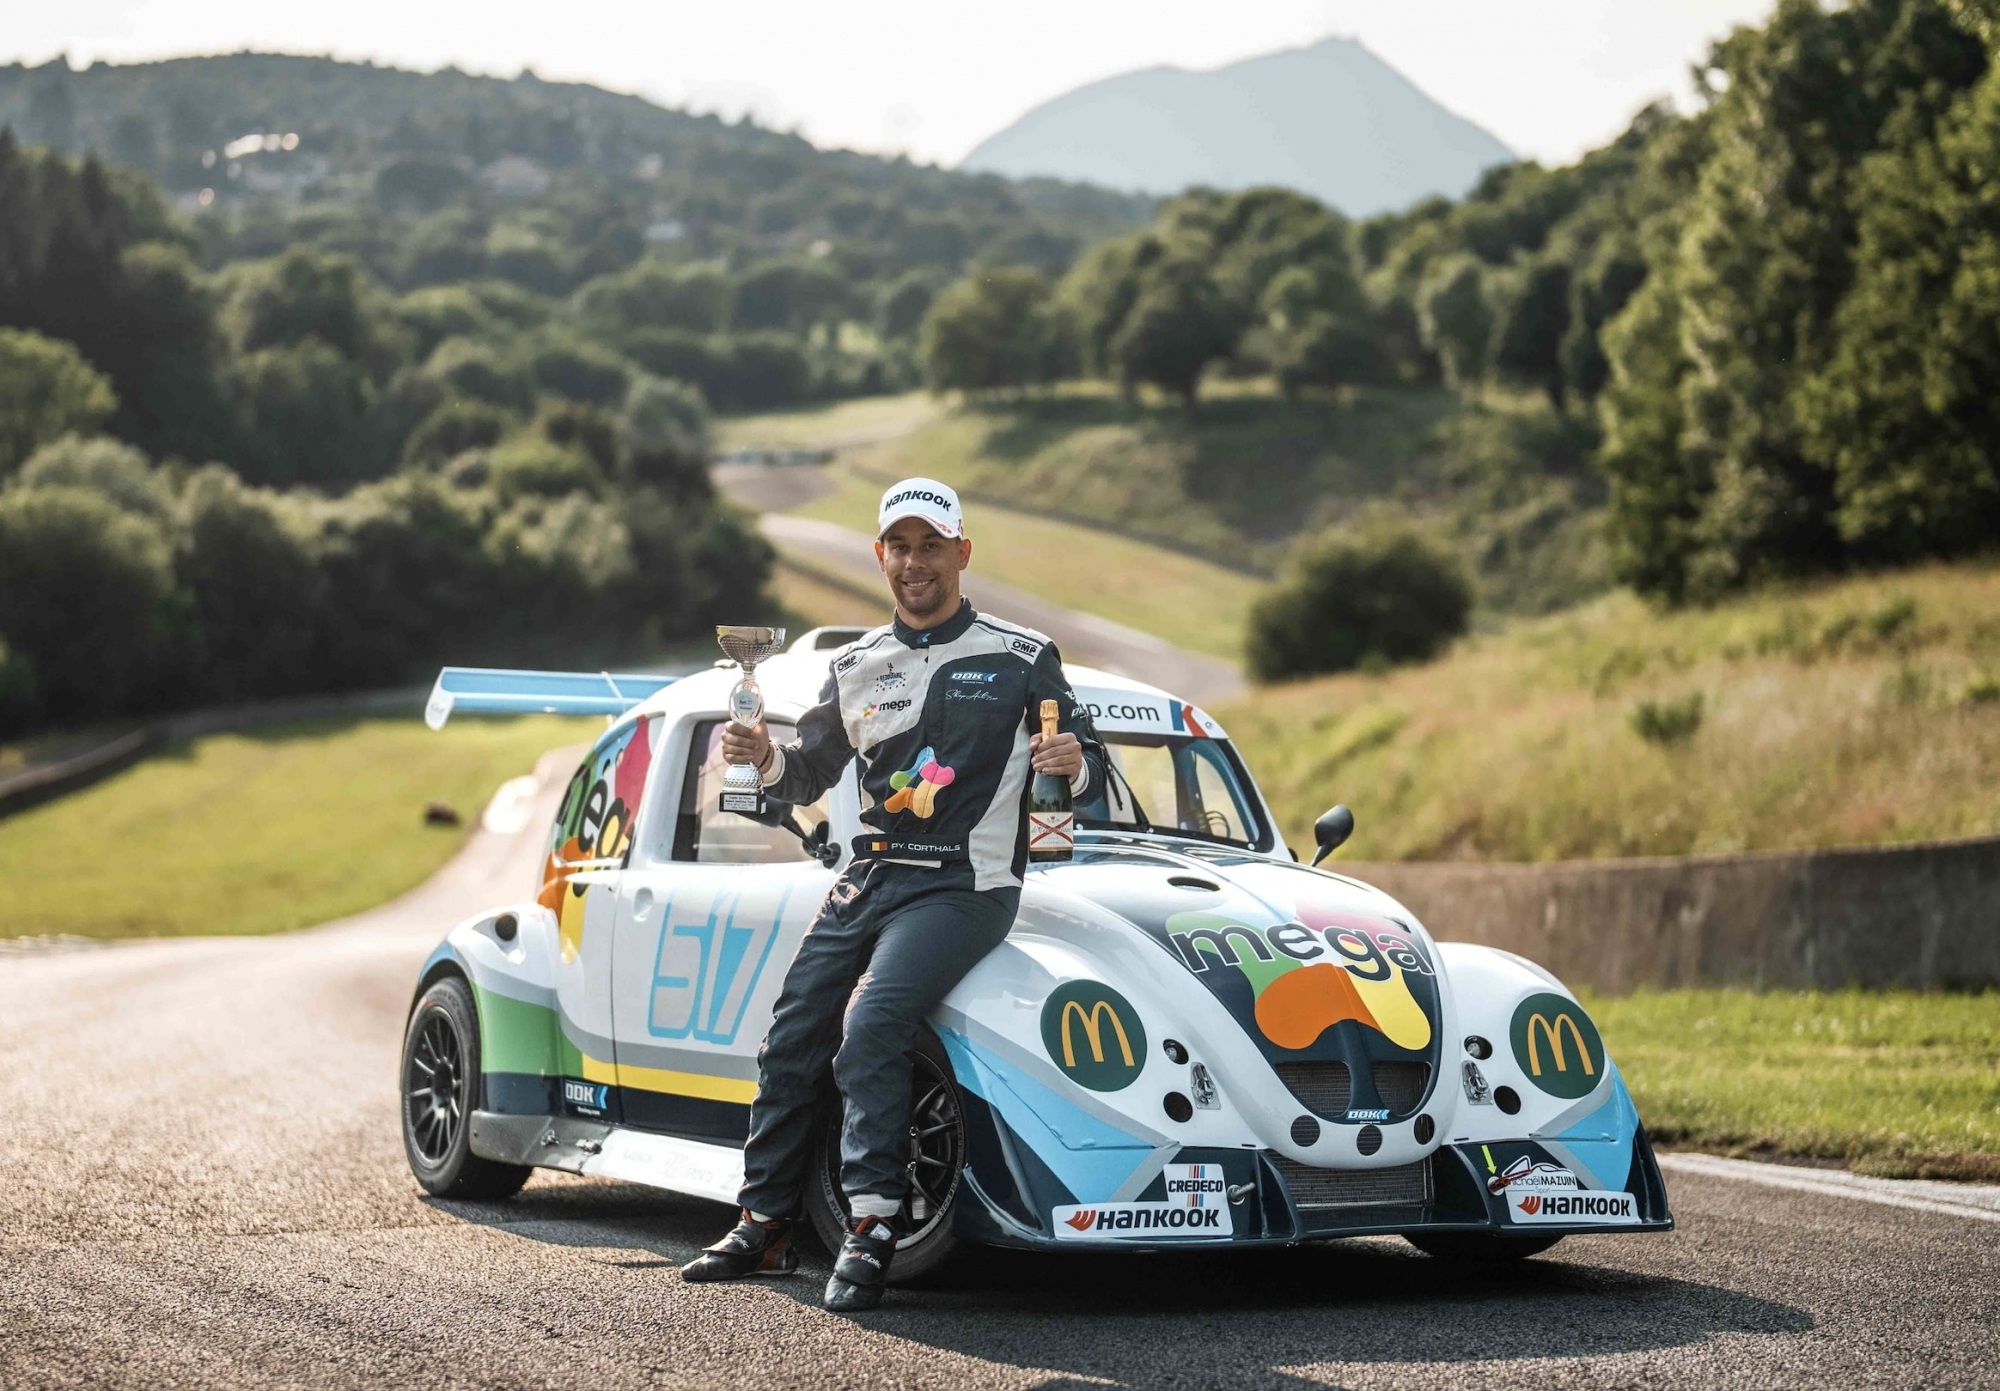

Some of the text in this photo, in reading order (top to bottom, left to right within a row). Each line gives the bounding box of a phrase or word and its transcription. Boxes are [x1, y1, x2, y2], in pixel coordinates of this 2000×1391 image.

[1012, 640, 1036, 654] OMP
[837, 655, 856, 672] OMP
[879, 699, 912, 711] mega
[908, 843, 960, 852] CORTHALS
[1168, 923, 1435, 983] mega
[648, 880, 795, 1045] 517
[1168, 1180, 1223, 1192] CREDECO
[1540, 1175, 1576, 1186] MAZUIN
[830, 1199, 844, 1222] TEAM
